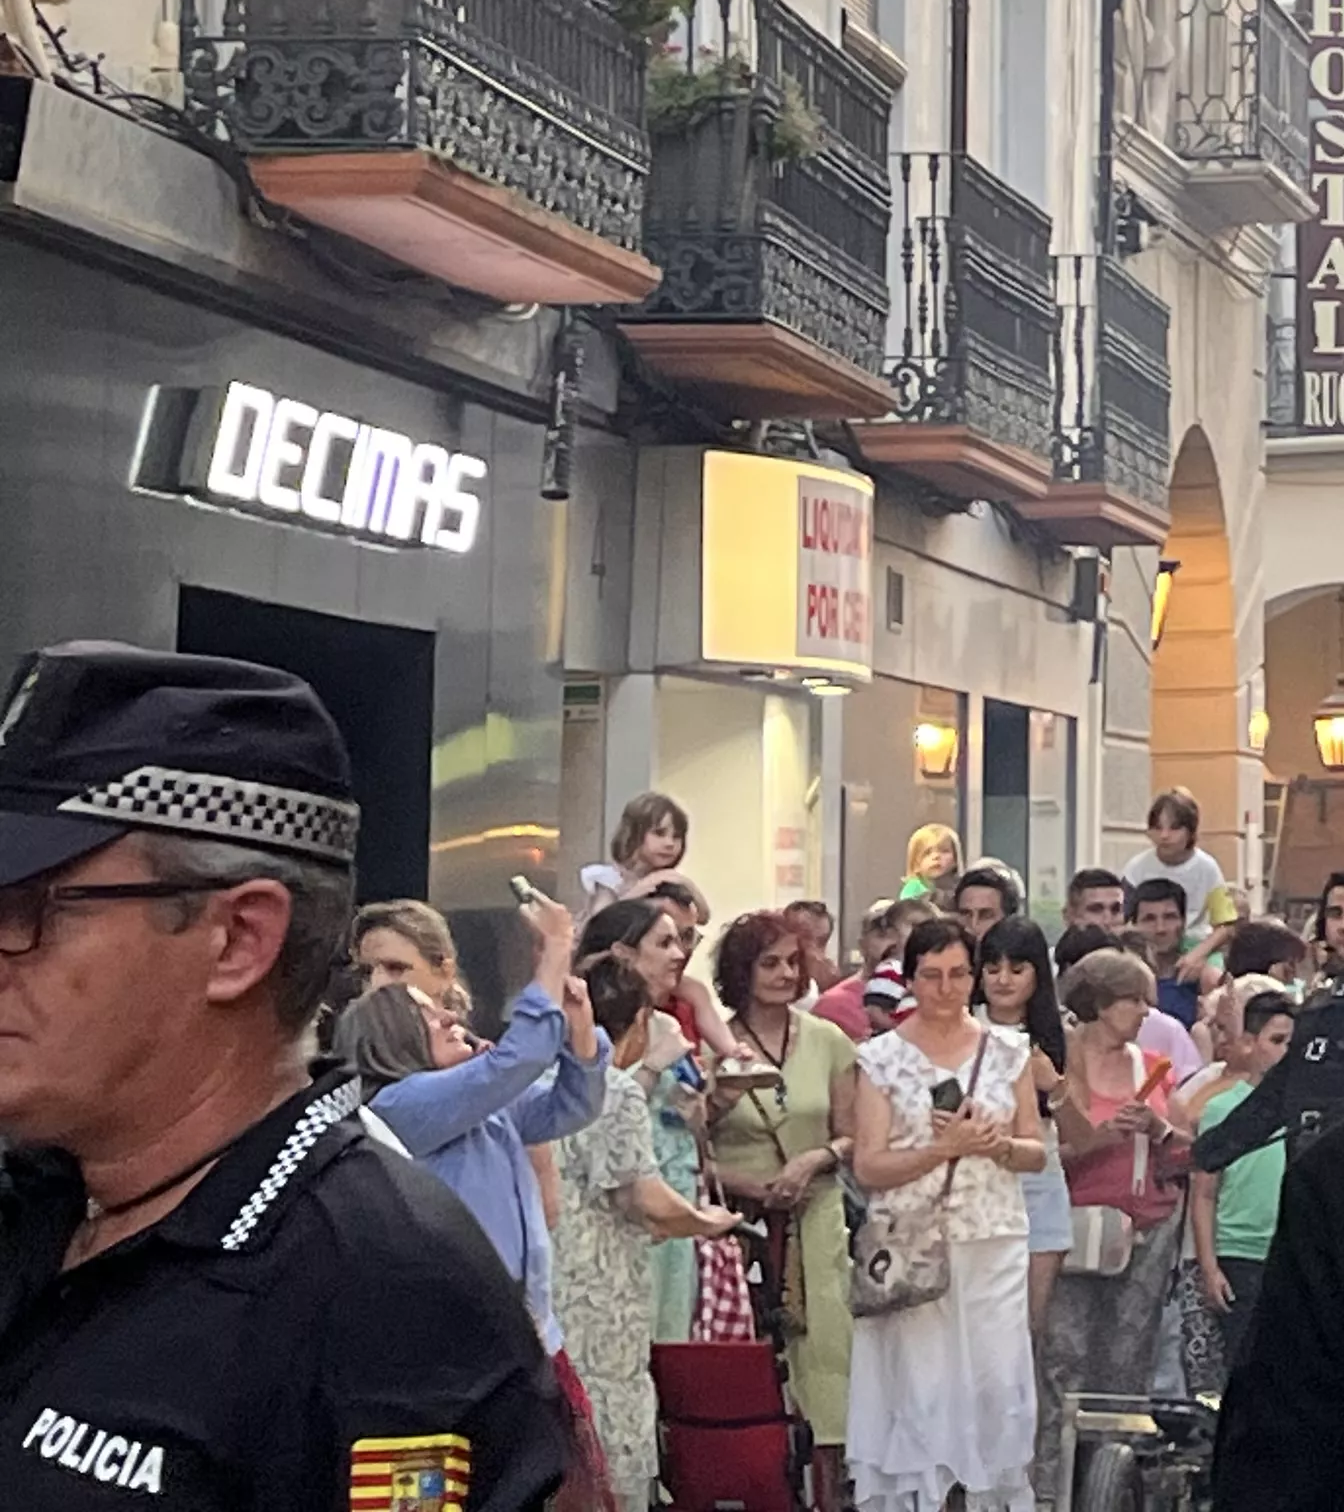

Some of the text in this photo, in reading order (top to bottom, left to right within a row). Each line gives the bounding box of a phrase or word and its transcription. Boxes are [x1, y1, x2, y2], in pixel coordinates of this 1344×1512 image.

[207, 380, 488, 553] DECIMAS
[806, 583, 839, 639] POR
[22, 1407, 165, 1494] POLICIA
